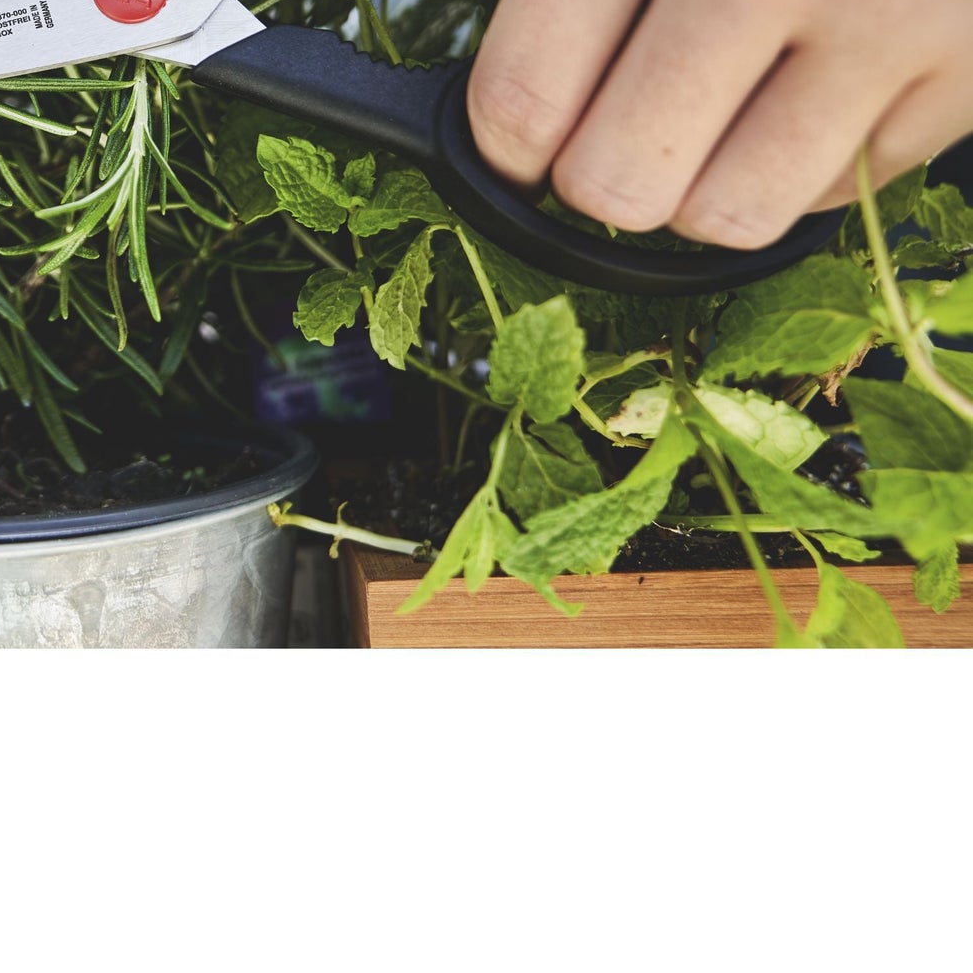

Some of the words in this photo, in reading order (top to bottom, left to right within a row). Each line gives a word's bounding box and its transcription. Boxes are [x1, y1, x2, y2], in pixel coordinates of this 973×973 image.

[29, 4, 38, 12] IN
[39, 0, 55, 28] GERMANY
[31, 11, 43, 29] MADE
